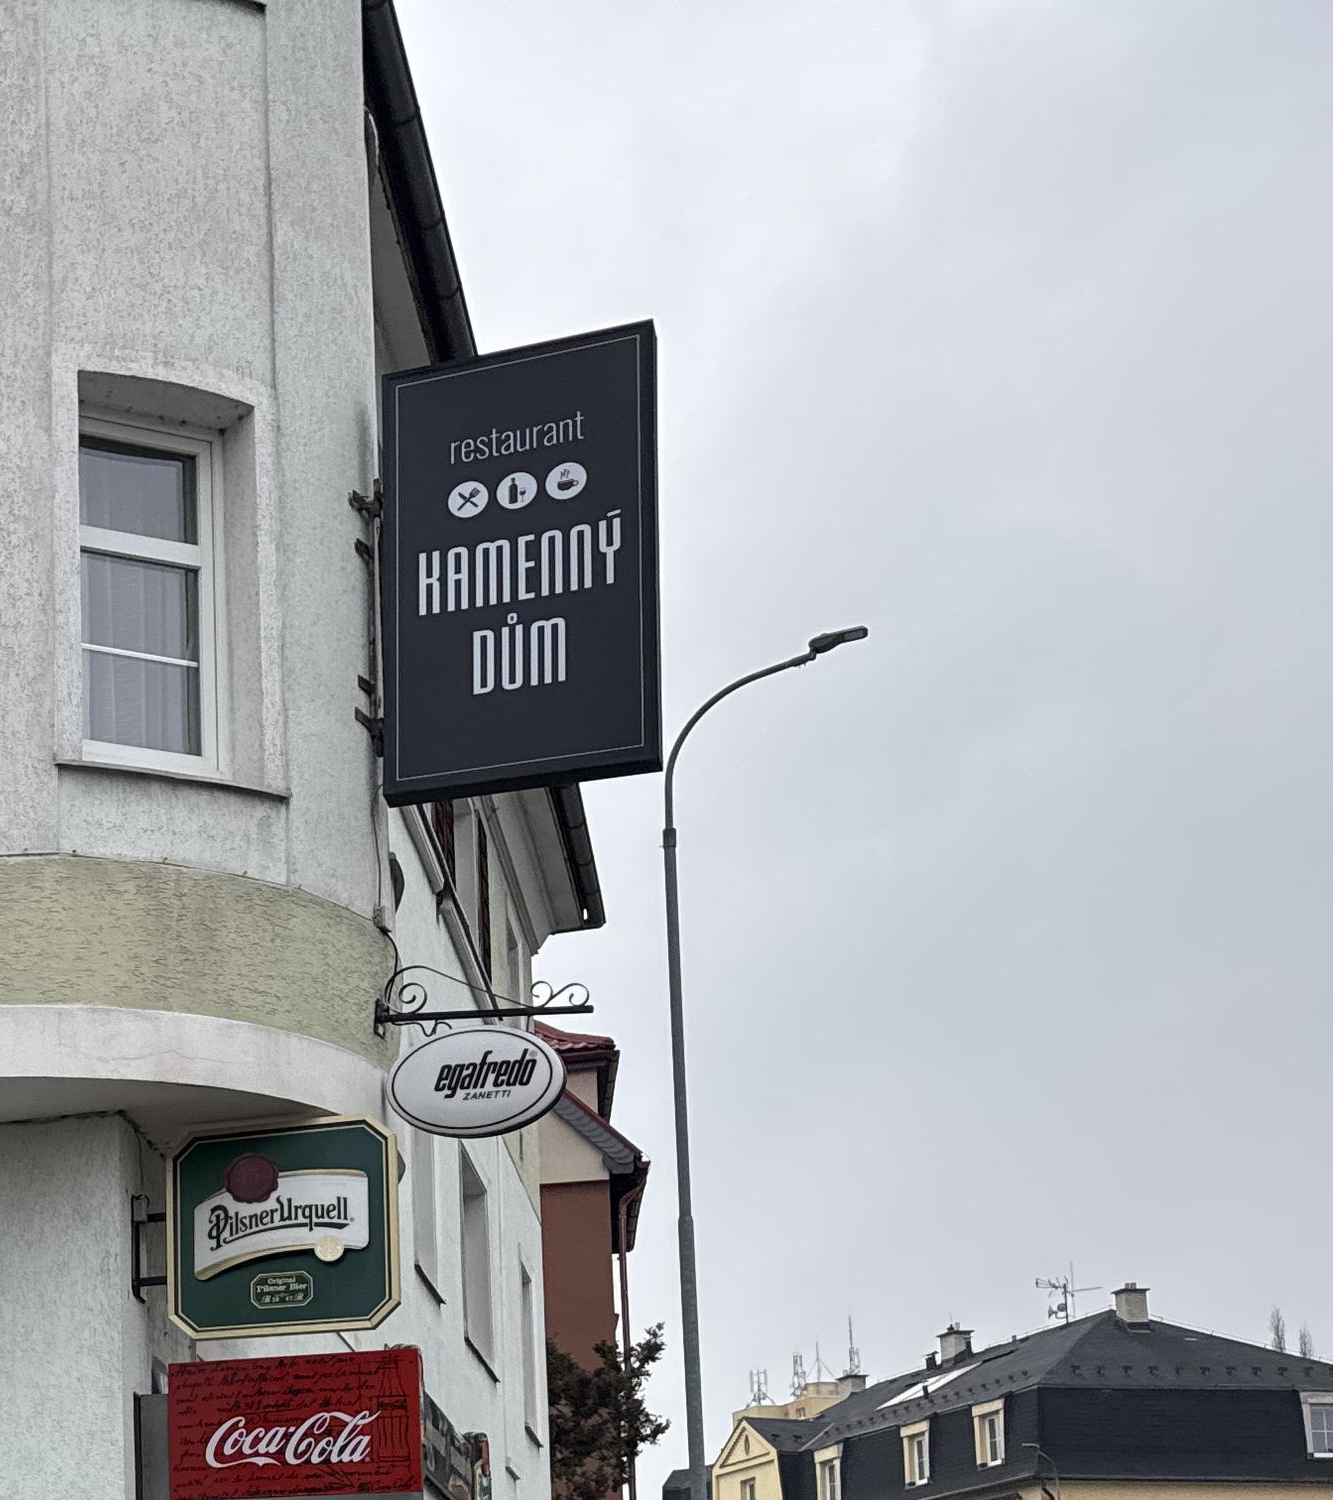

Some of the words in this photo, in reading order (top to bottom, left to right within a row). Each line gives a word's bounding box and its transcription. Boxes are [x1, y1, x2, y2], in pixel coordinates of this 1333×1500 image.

[449, 411, 586, 464] restaurant
[418, 508, 622, 616] KAMENNÝ
[472, 612, 566, 695] DŮM
[462, 1089, 511, 1100] ZANETTI
[207, 1204, 279, 1251] Pilsner
[276, 1195, 349, 1232] Urquell
[205, 1410, 381, 1468] Coca-Cola
